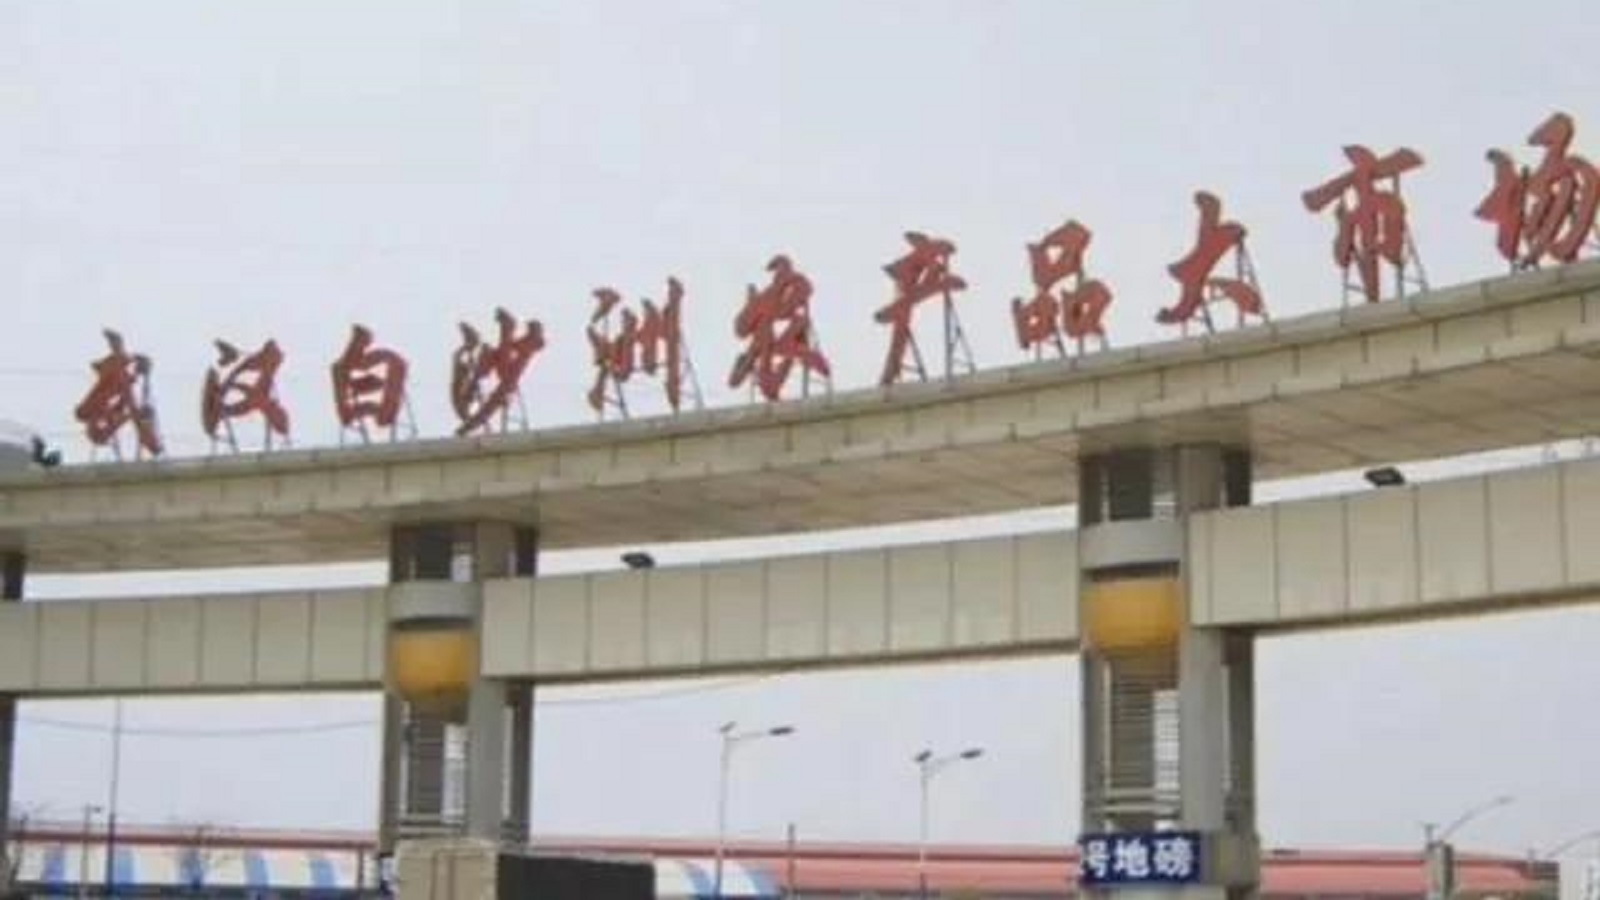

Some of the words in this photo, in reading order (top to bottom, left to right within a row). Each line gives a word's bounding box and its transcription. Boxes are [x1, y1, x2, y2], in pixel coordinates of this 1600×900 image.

[75, 111, 1600, 455] 武汉白沙洲农产品大市场
